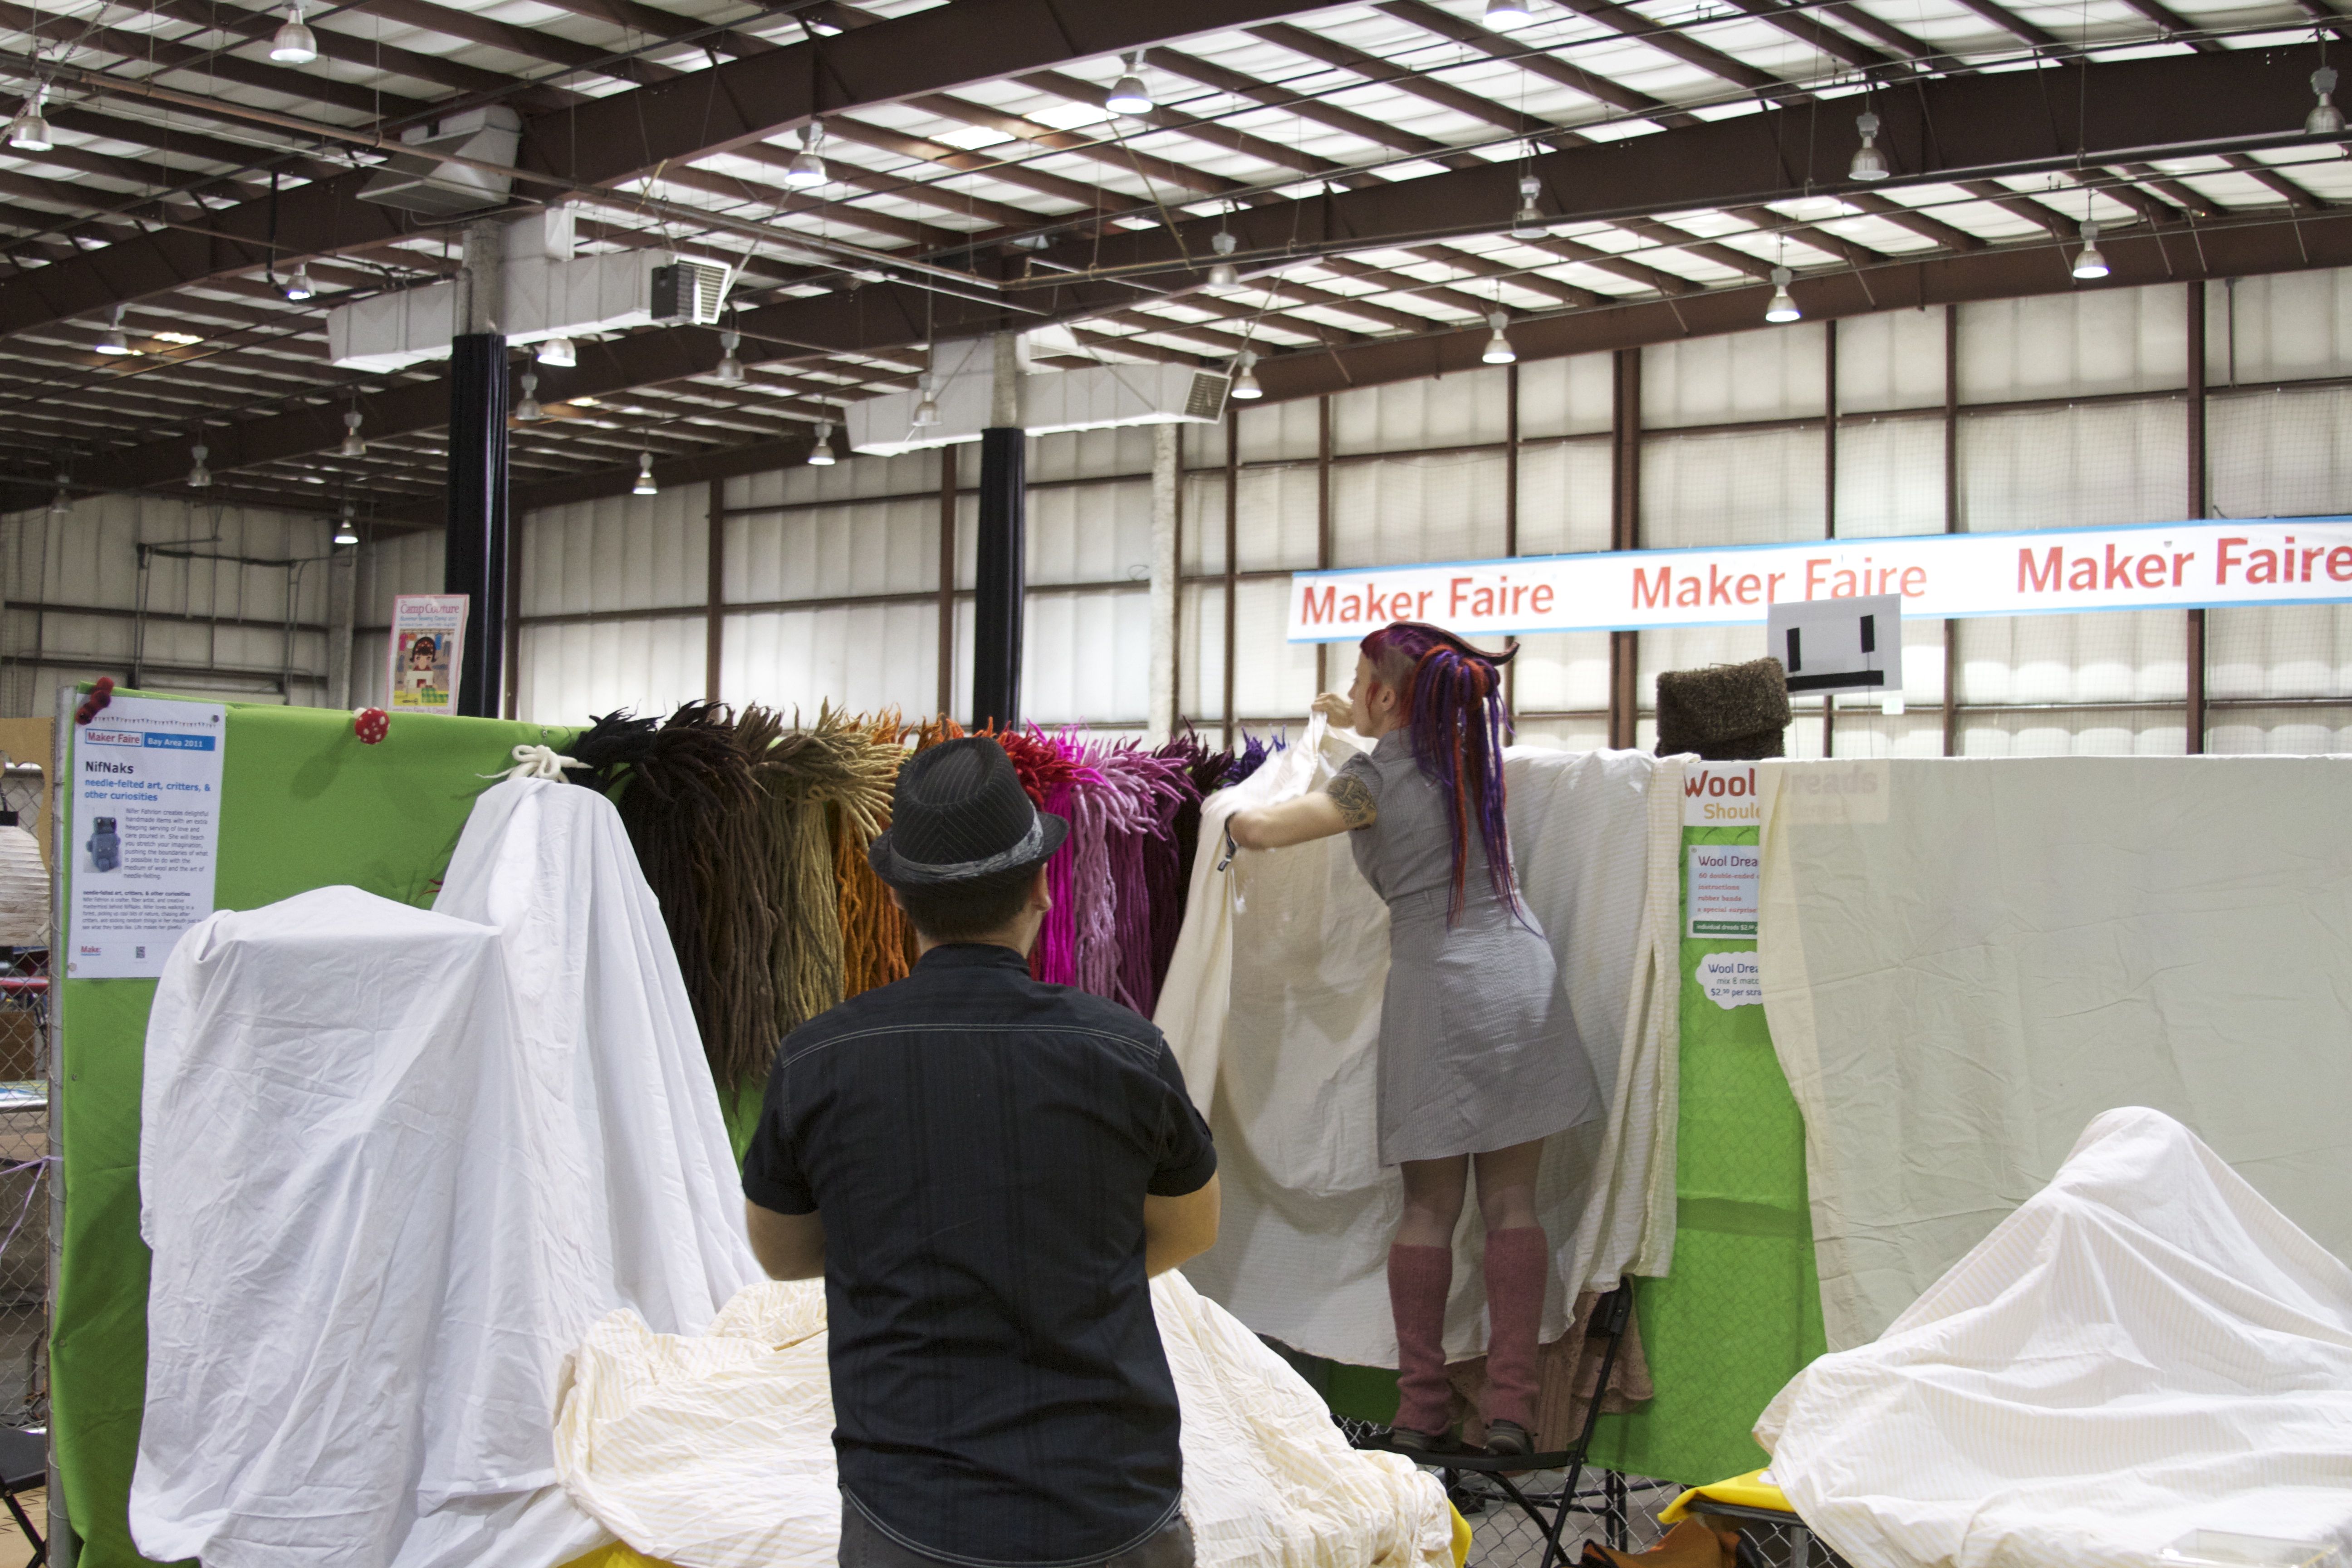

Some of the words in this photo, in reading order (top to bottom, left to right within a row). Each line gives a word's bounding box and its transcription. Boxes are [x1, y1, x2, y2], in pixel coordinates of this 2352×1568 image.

[2018, 544, 2195, 593] Maker
[2216, 536, 2352, 585] Faire
[1632, 564, 1785, 610] Maker
[1805, 557, 1927, 602] Faire
[1301, 583, 1433, 625] Maker
[1449, 576, 1554, 618] Faire
[401, 604, 424, 615] Camp
[88, 732, 114, 742] Maker
[118, 734, 140, 744] Faire
[148, 738, 162, 746] Bay
[86, 761, 133, 774] NifNaks
[85, 779, 144, 789] needle-felted
[147, 781, 163, 790] art,
[166, 783, 201, 792] critters,
[1684, 768, 1756, 798] Wool
[84, 790, 107, 799] other
[111, 793, 158, 801] curiosities
[1698, 856, 1726, 867] Wool
[1708, 963, 1734, 973] Wool
